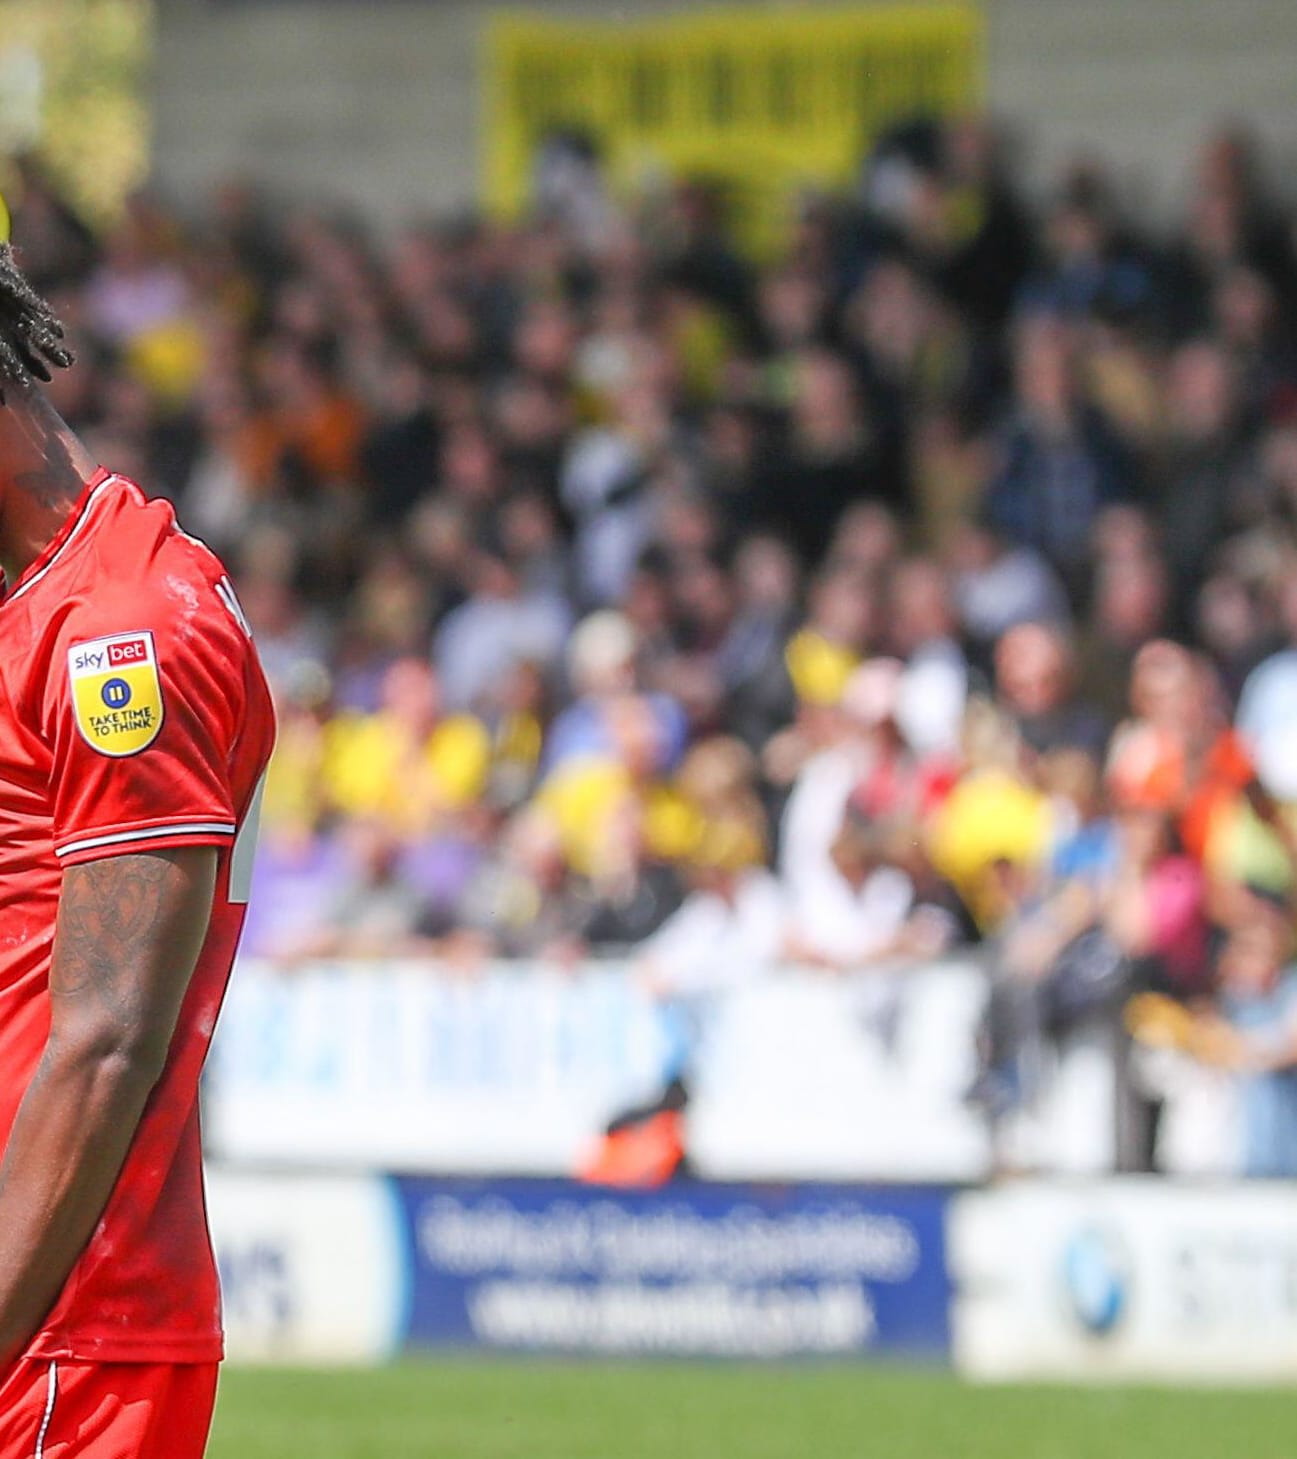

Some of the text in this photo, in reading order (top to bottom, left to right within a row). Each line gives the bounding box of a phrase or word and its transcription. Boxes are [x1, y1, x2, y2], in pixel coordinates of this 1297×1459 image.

[75, 643, 143, 669] sky bet
[89, 706, 152, 728] TAKE TIME
[94, 719, 153, 737] TO THINK
